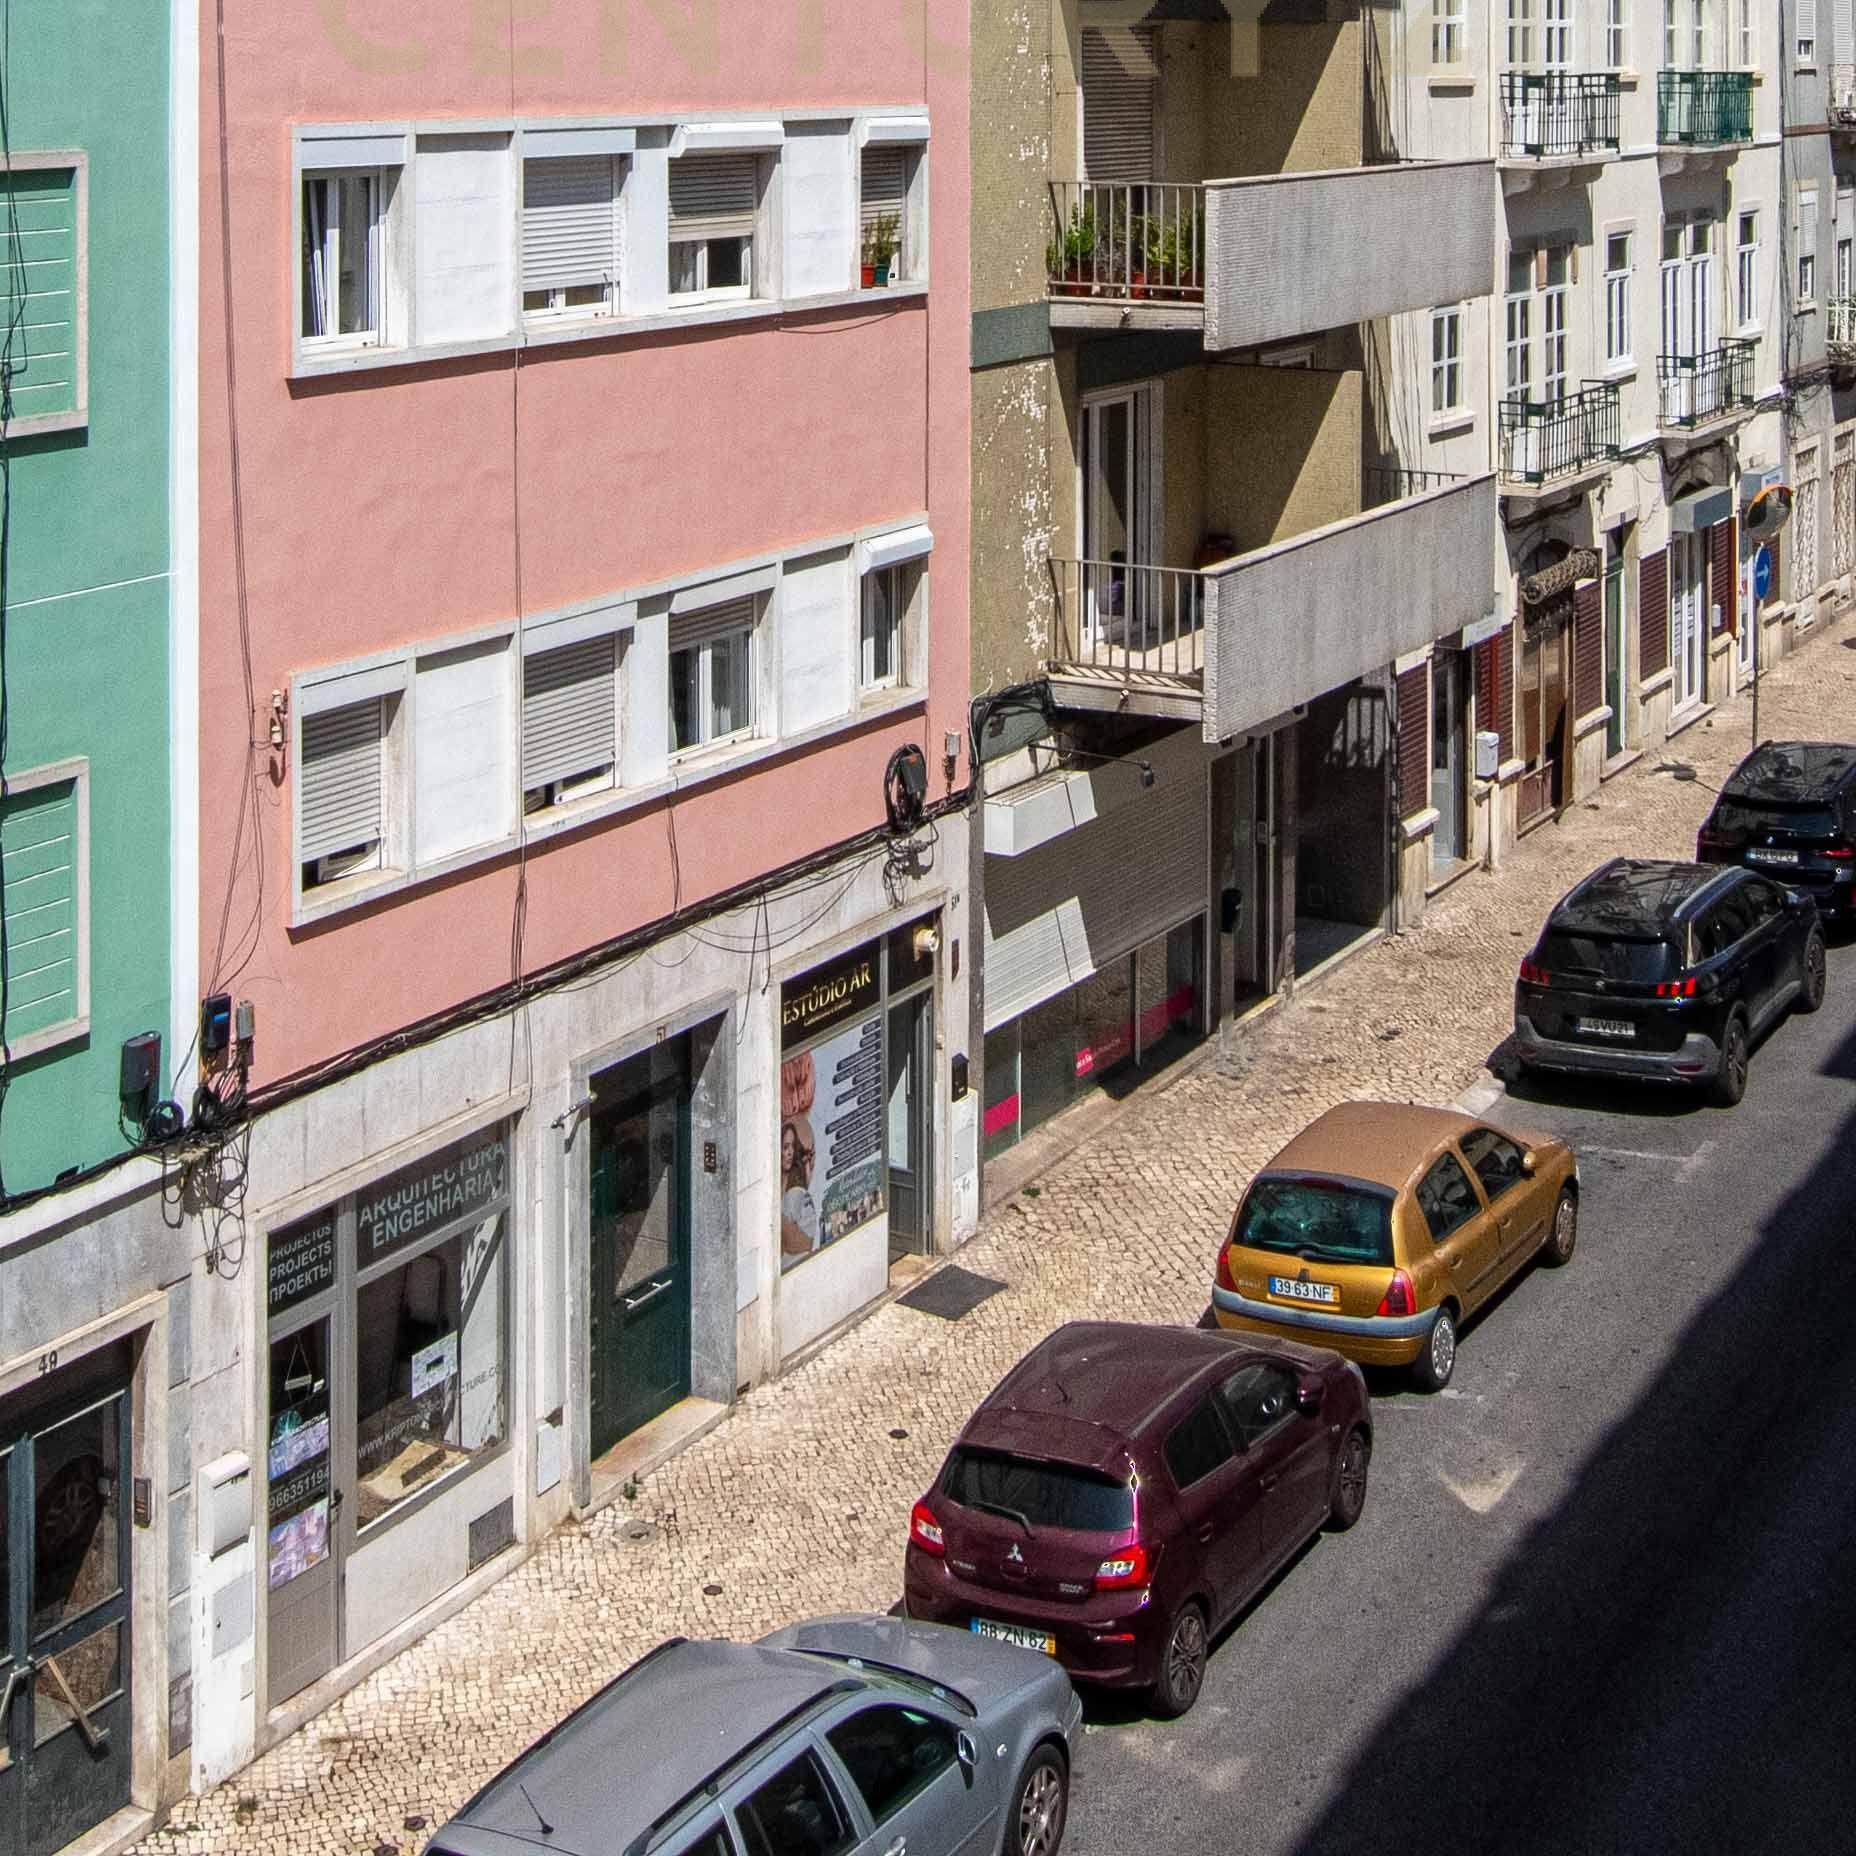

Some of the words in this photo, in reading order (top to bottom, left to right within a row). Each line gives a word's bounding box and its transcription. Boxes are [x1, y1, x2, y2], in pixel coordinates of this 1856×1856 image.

[784, 976, 847, 1025] ESTÚDIO
[849, 962, 872, 993] AR
[373, 1169, 494, 1249] ENGENHARIA
[269, 1259, 332, 1305] ПРОЕКТЫ
[270, 1240, 332, 1284] PROJECTS
[38, 1350, 58, 1374] 49
